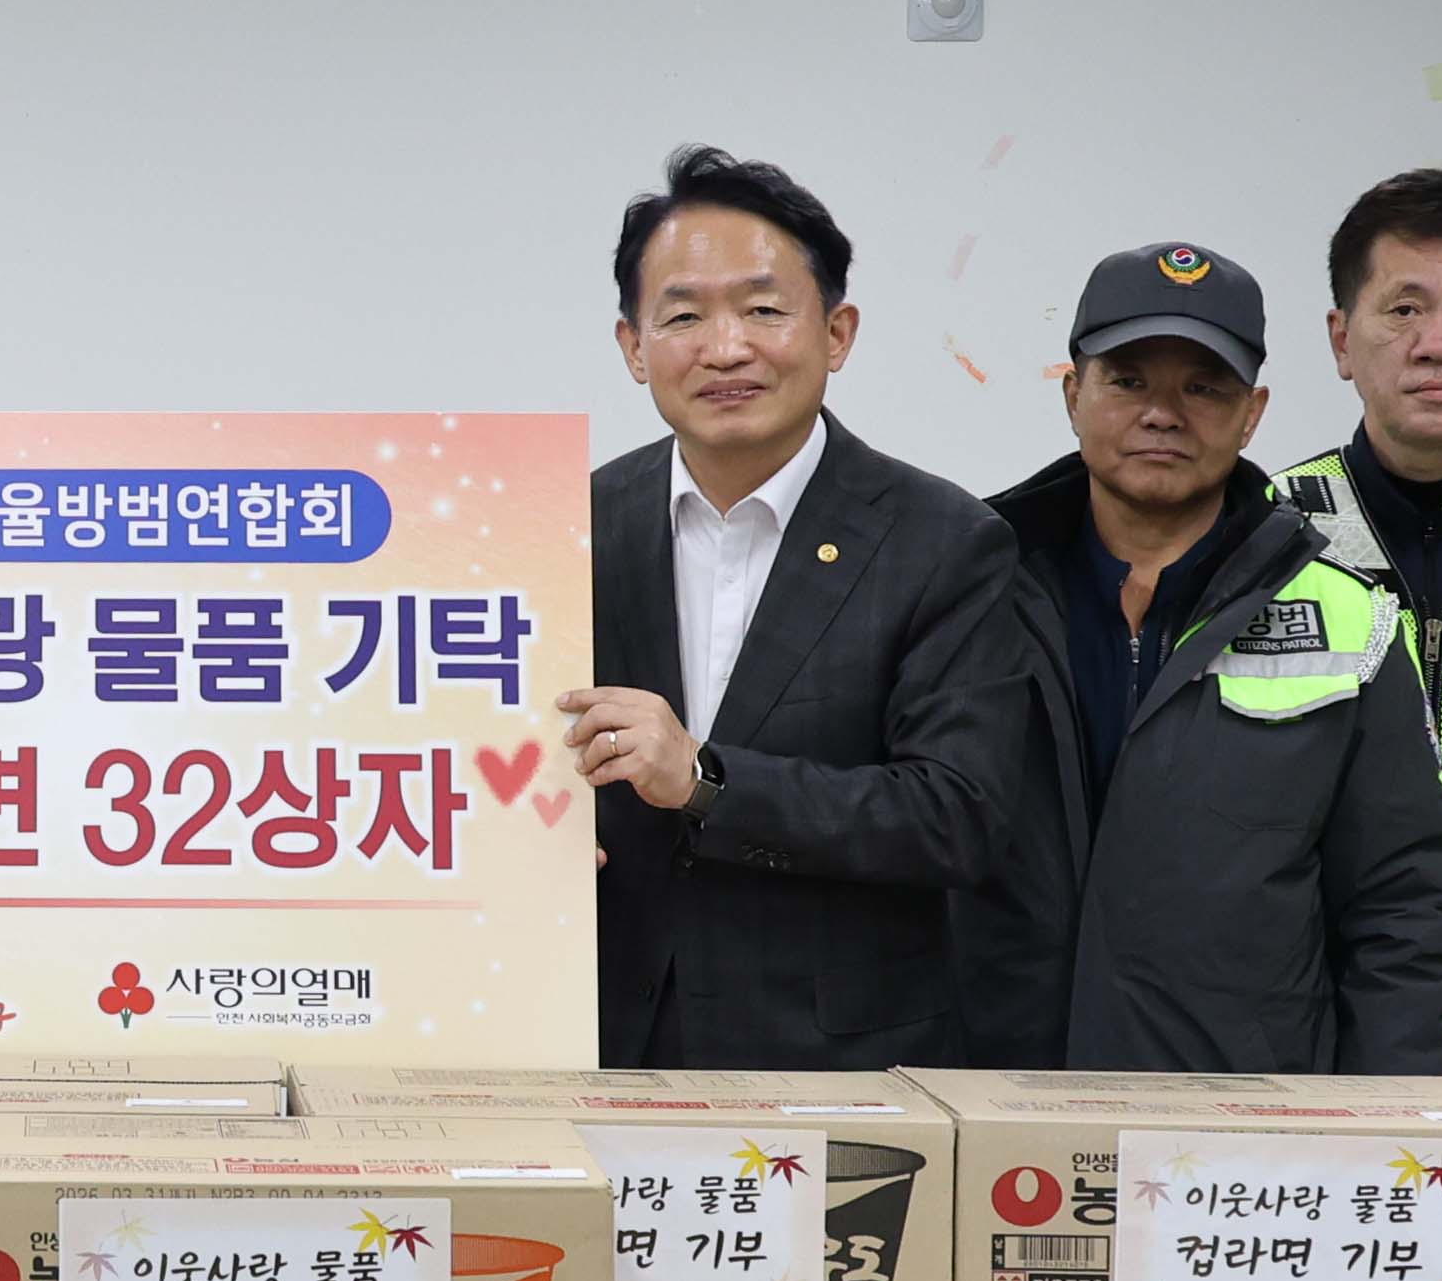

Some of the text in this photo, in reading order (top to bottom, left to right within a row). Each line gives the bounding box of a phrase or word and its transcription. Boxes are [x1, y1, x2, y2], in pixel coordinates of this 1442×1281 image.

[87, 598, 289, 703] 물품
[324, 595, 532, 705] 기탁
[1282, 638, 1323, 650] PATROL
[82, 747, 468, 871] 32상자
[166, 967, 371, 1009] 사랑의열매
[215, 1012, 371, 1028] 인천 사회복지공동모금회
[611, 1175, 761, 1214] 사랑 물품
[1186, 1182, 1417, 1224] 이웃사랑 물품
[685, 1229, 769, 1271] 기부
[1177, 1235, 1423, 1281] 컵라면 기부
